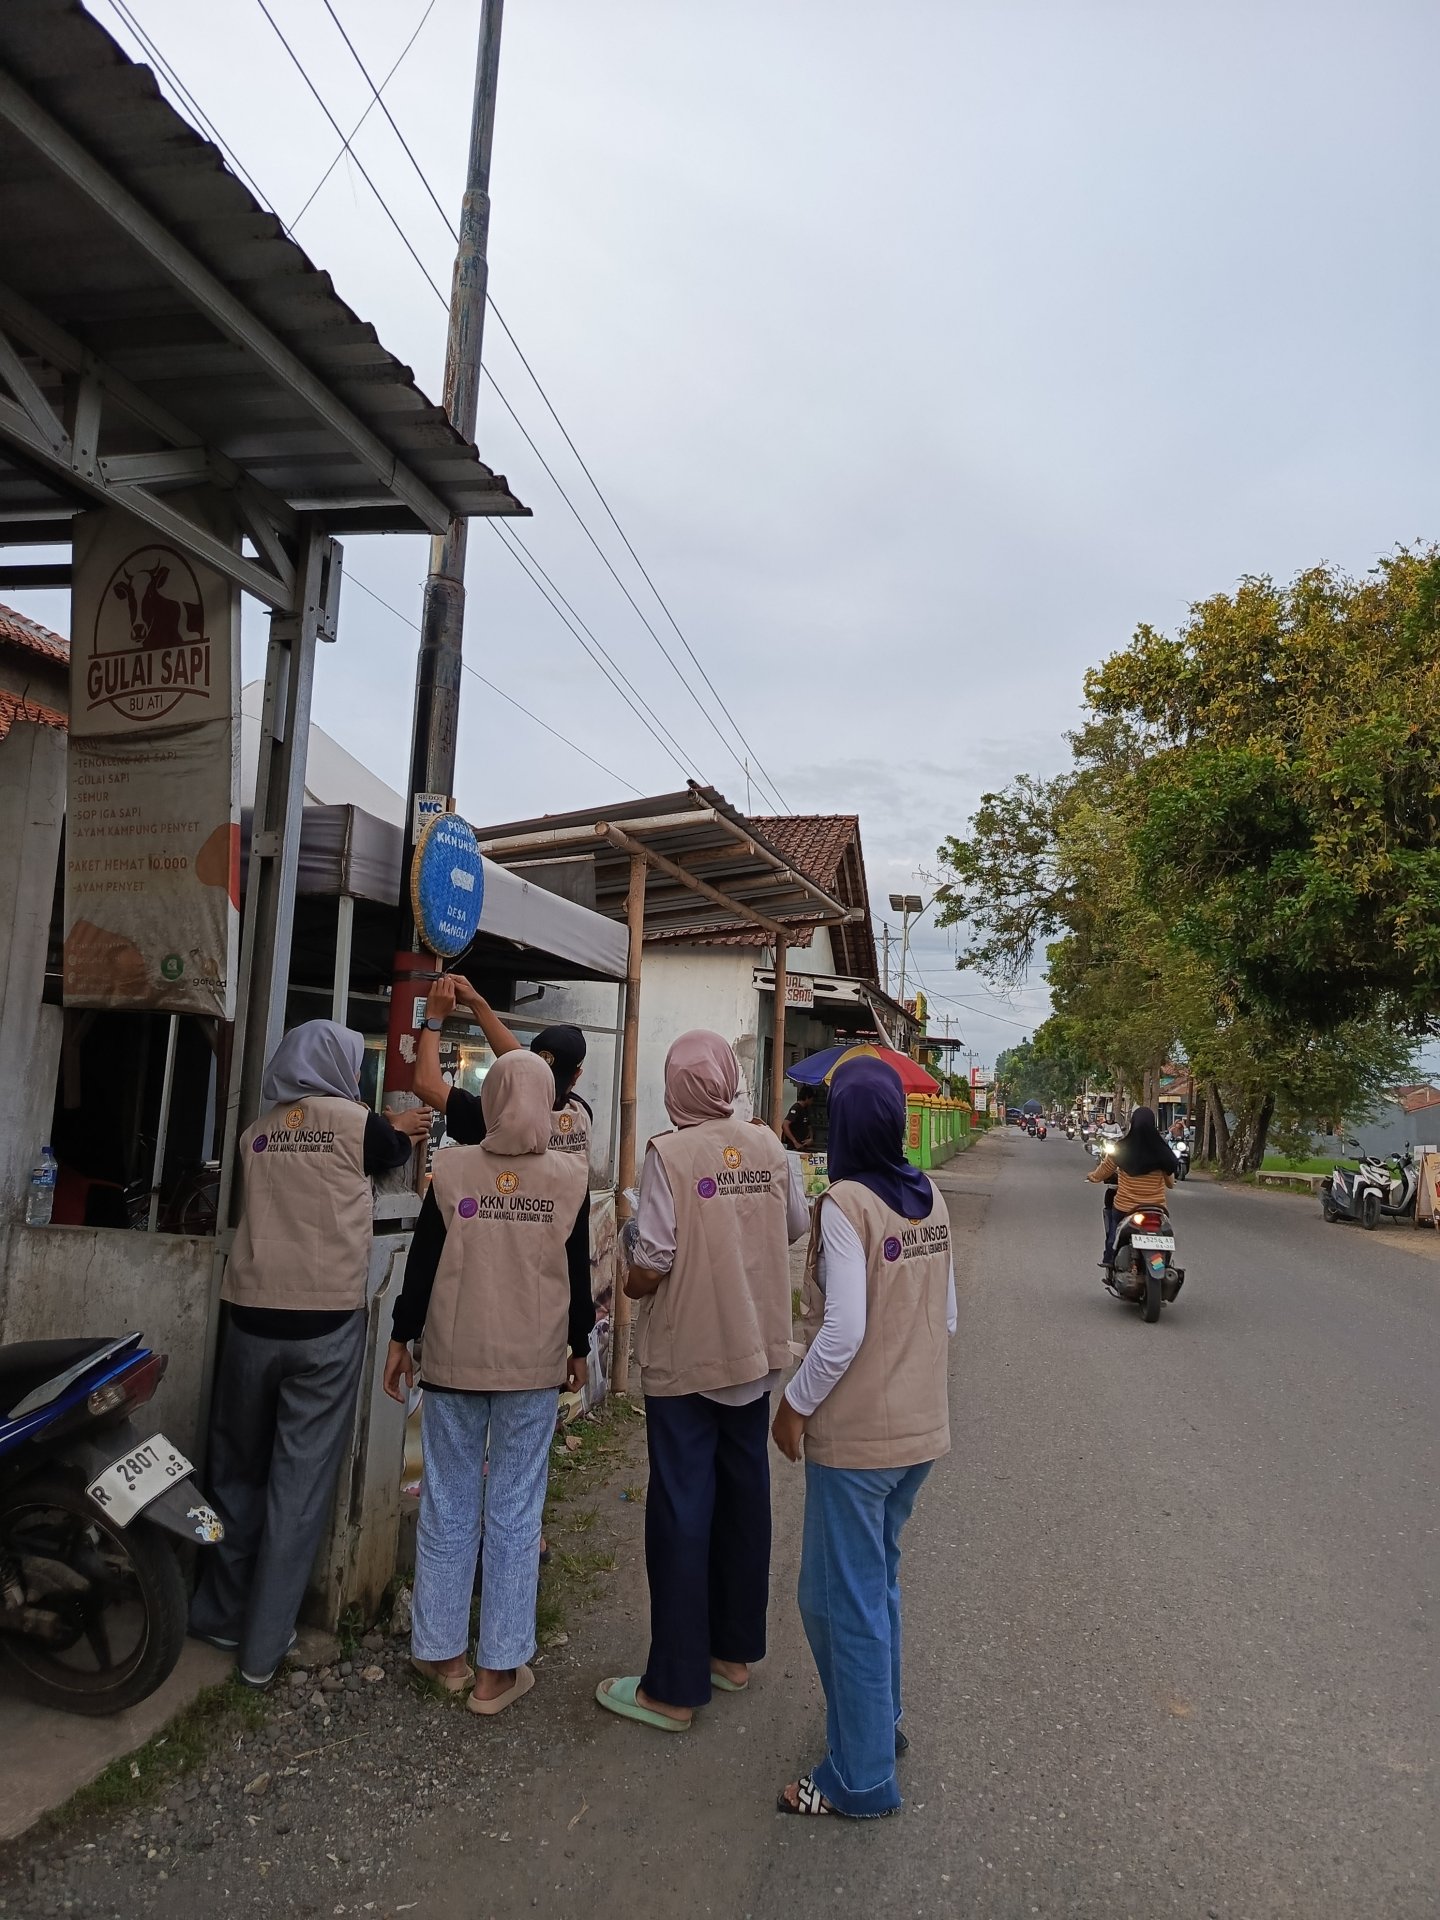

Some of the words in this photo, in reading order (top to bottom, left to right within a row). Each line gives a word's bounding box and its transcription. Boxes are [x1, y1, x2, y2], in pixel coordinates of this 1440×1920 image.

[87, 653, 153, 700] GULAI
[160, 645, 210, 687] SAPI
[129, 698, 144, 711] BU
[147, 694, 163, 710] ATI
[108, 773, 130, 784] SAPI
[100, 808, 116, 819] IGA
[119, 807, 141, 818] SAPI
[418, 801, 443, 813] WC
[108, 824, 157, 836] KAMPUNG
[161, 822, 200, 834] PENYET
[68, 860, 101, 873] PAKET
[104, 858, 145, 871] HEMAT
[106, 881, 145, 892] PENYET
[447, 904, 466, 922] DESA
[438, 920, 468, 940] MANGLI
[785, 976, 804, 988] UAL
[270, 1130, 291, 1143] KKN
[294, 1130, 335, 1143] UNSOED
[547, 1134, 564, 1147] KKN
[716, 1172, 735, 1186] KKN
[737, 1170, 772, 1185] UNSOED
[480, 1195, 505, 1210] KKN
[509, 1197, 555, 1213] UNSOED
[478, 1210, 492, 1219] DESA
[516, 1213, 540, 1223] KEBUMEN
[541, 1214, 554, 1224] 2026
[901, 1229, 918, 1248] KKN
[920, 1224, 948, 1243] UNSOED
[91, 1486, 113, 1506] R
[116, 1445, 160, 1483] 2807
